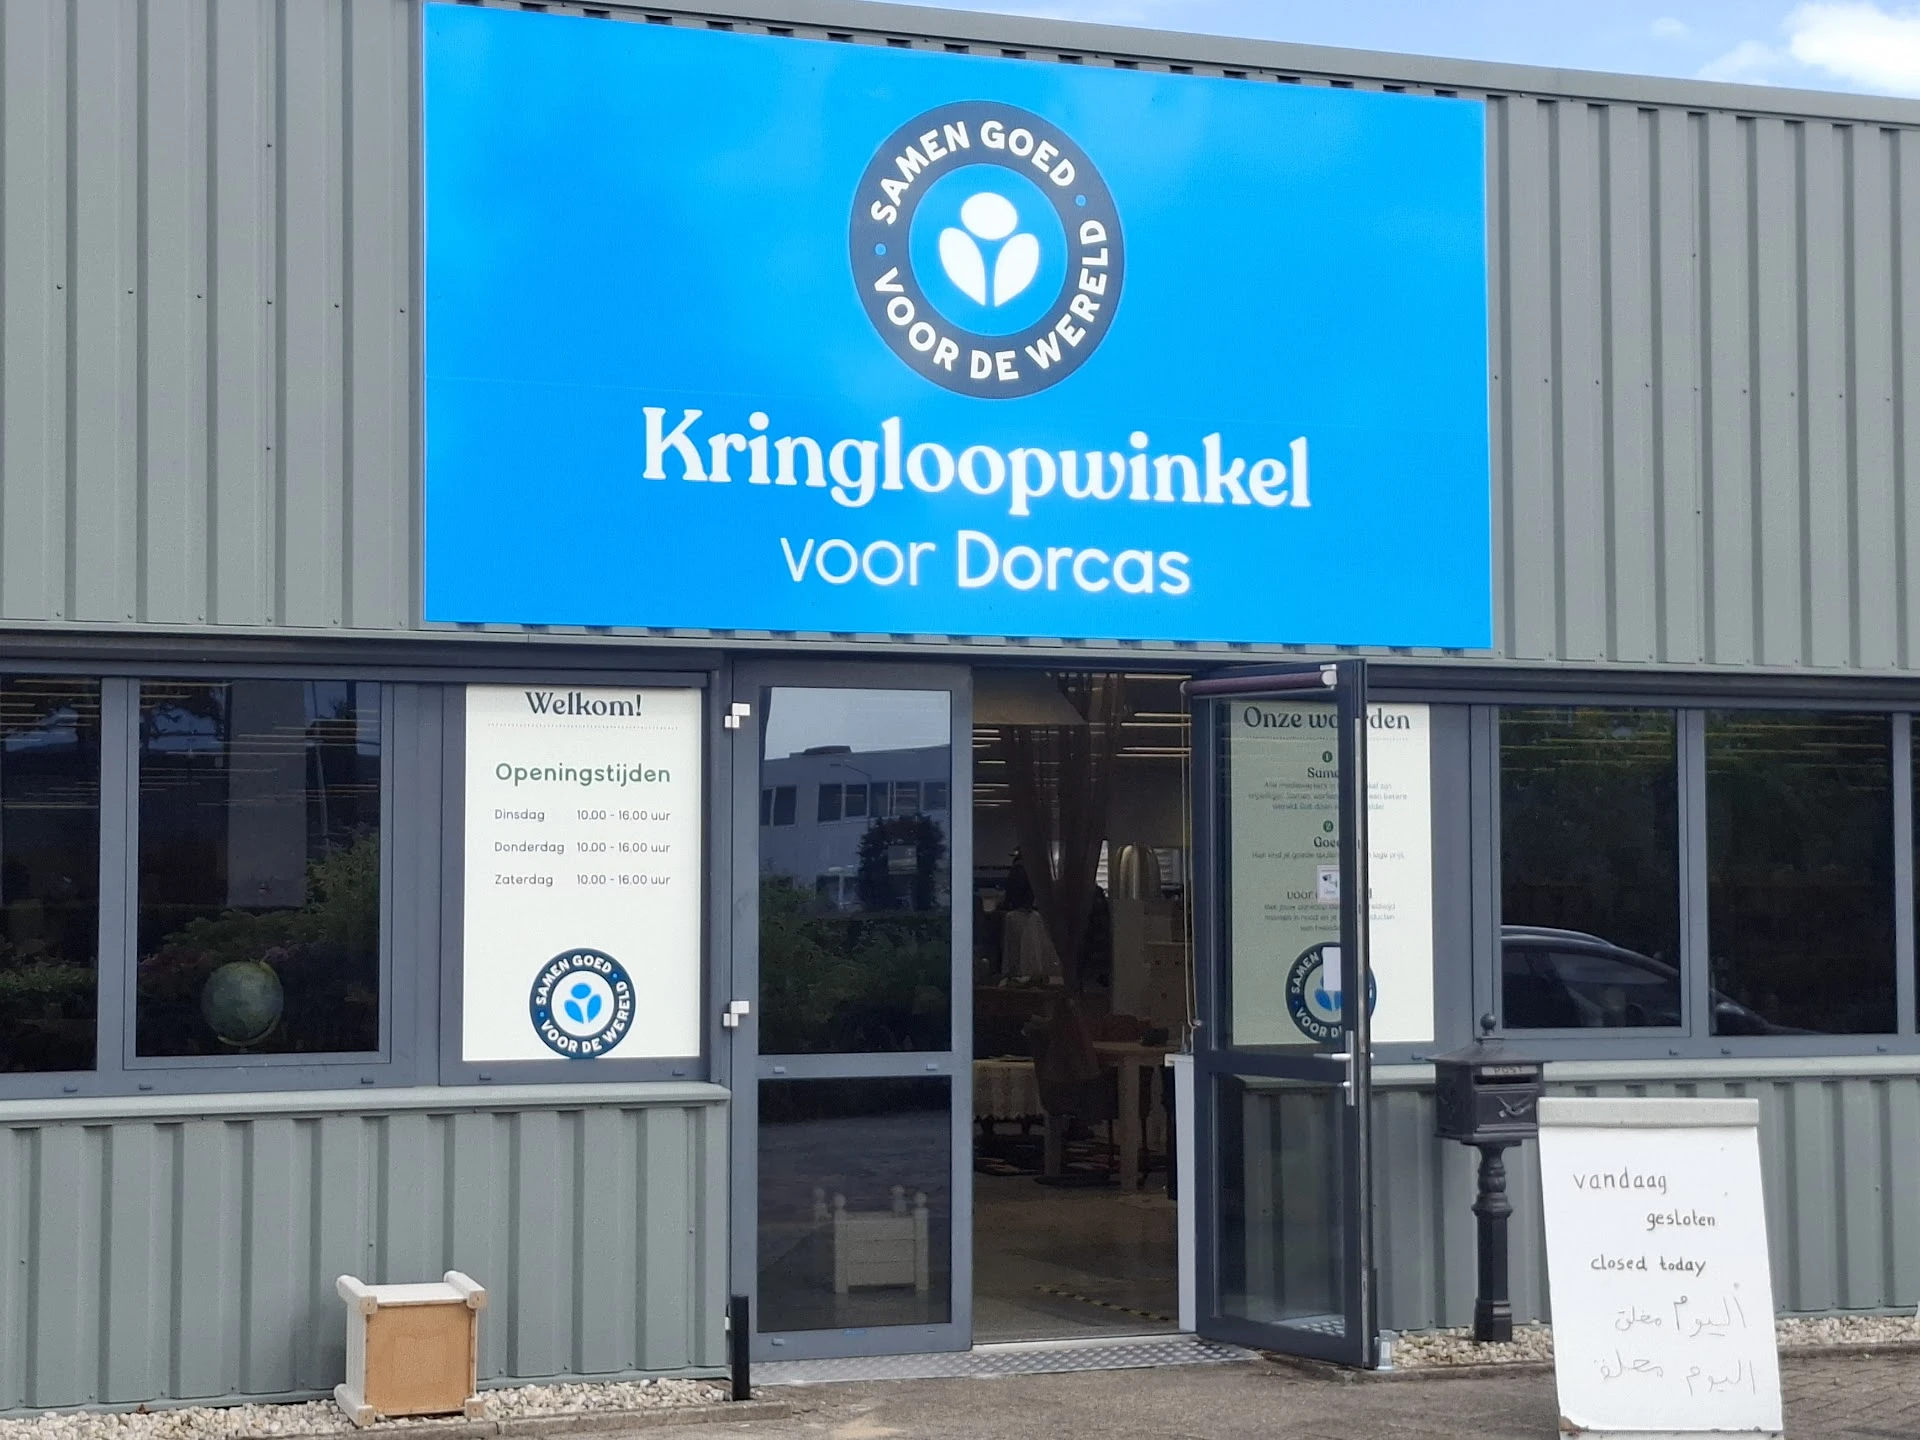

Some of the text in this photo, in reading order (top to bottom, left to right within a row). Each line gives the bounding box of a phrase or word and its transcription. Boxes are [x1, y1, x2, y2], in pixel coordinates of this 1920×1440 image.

[871, 120, 1075, 225] SAMEN GOED
[874, 220, 1108, 381] VOOR DE WERELD
[642, 406, 1311, 516] Kringloopwinkel
[779, 530, 1191, 595] voor Dorcas
[525, 691, 642, 717] Welkom!
[1244, 706, 1302, 728] Onze
[495, 762, 671, 787] Openingstijden
[495, 809, 545, 822] Dinsdag
[577, 810, 607, 821] 10.00
[618, 810, 648, 821] 16.00
[650, 811, 671, 821] uur
[495, 842, 565, 854] Donderdag
[577, 842, 607, 853] 10.00
[618, 842, 648, 853] 16.00
[650, 844, 671, 853] uur
[495, 874, 553, 887] Zaterdag
[577, 874, 607, 885] 10.00
[618, 874, 648, 885] 16.00
[650, 876, 671, 886] uur
[536, 954, 612, 1006] SAMEN GOED
[1292, 952, 1320, 993] SAMEN
[541, 980, 630, 1053] VOOR DE WERELD
[1296, 1007, 1327, 1037] VOOR
[1573, 1167, 1667, 1195] vandaag
[1646, 1209, 1715, 1230] gesloten
[1591, 1256, 1706, 1276] closed today
